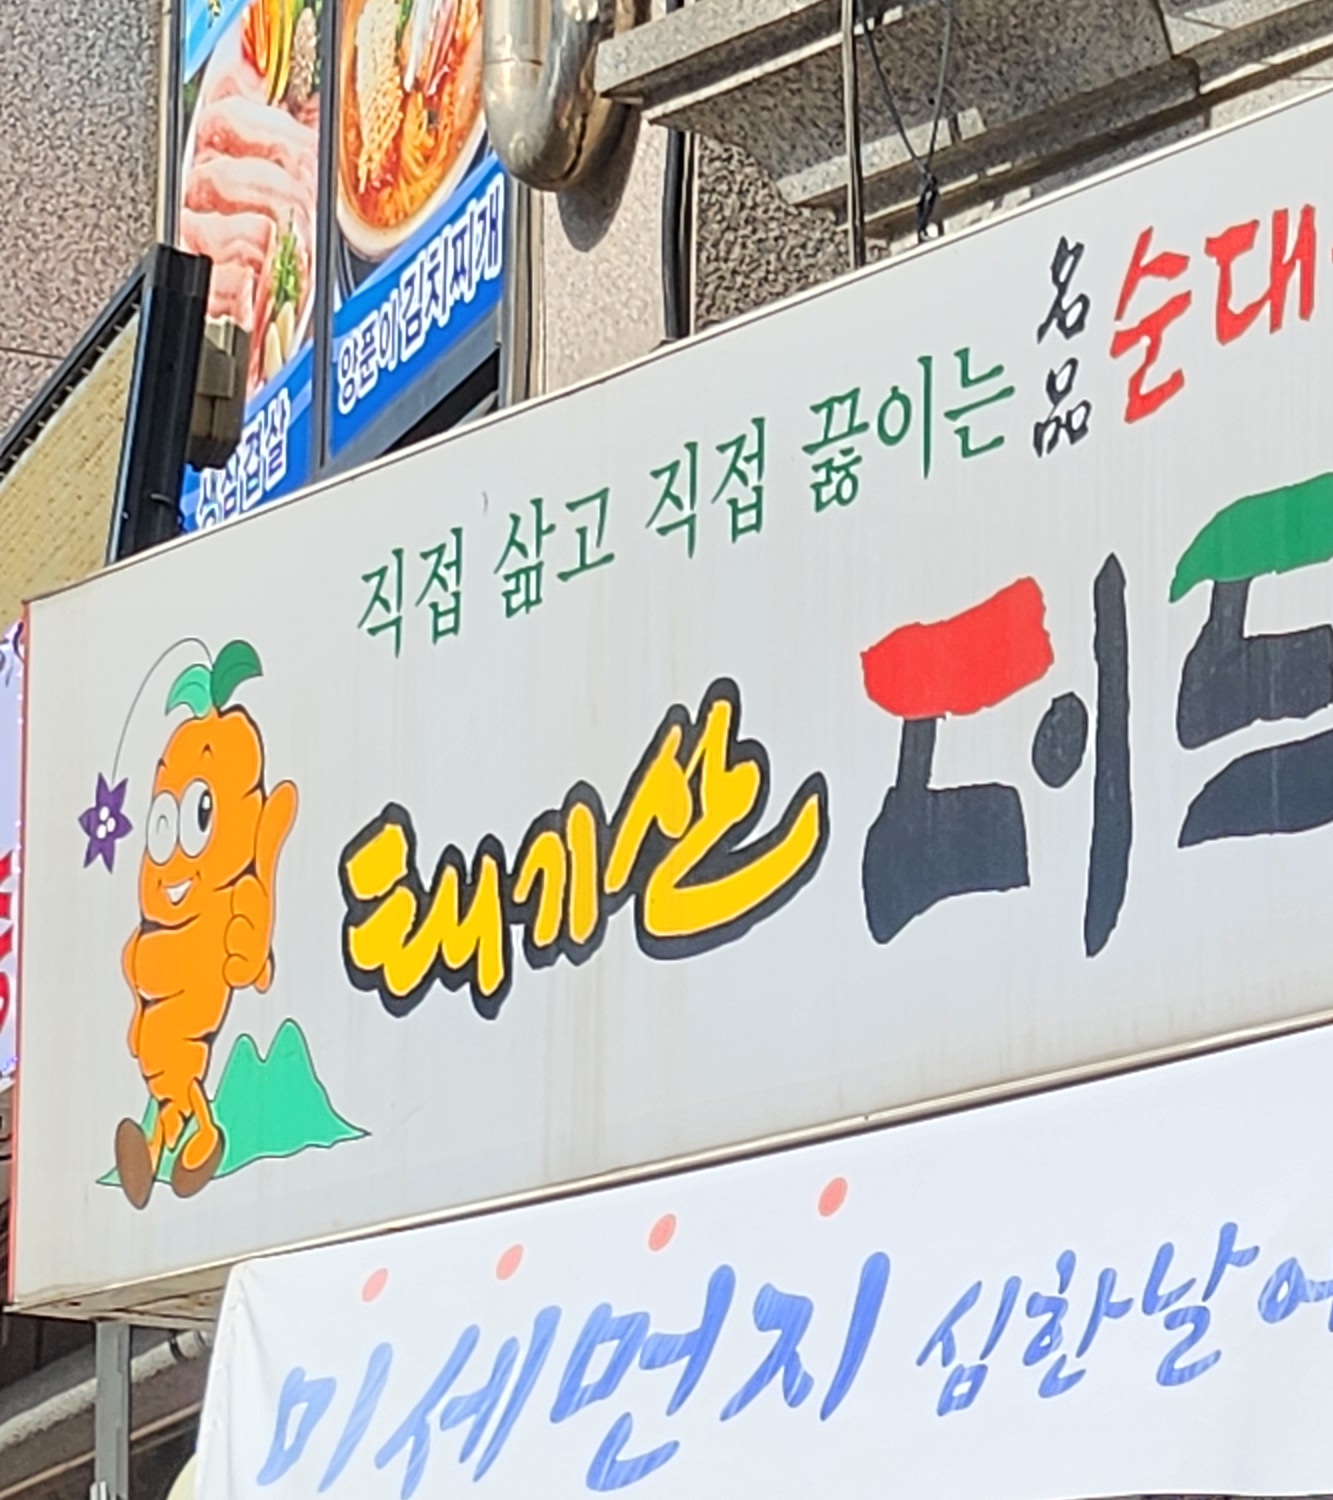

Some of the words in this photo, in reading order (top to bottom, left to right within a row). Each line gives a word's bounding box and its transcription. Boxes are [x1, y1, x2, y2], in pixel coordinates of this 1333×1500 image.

[358, 528, 464, 658] 직접
[494, 489, 615, 619] 삶고
[646, 417, 767, 560] 직접
[801, 346, 1016, 514] 끓이는
[1032, 235, 1094, 459] 名品
[338, 677, 830, 1019] 태기산
